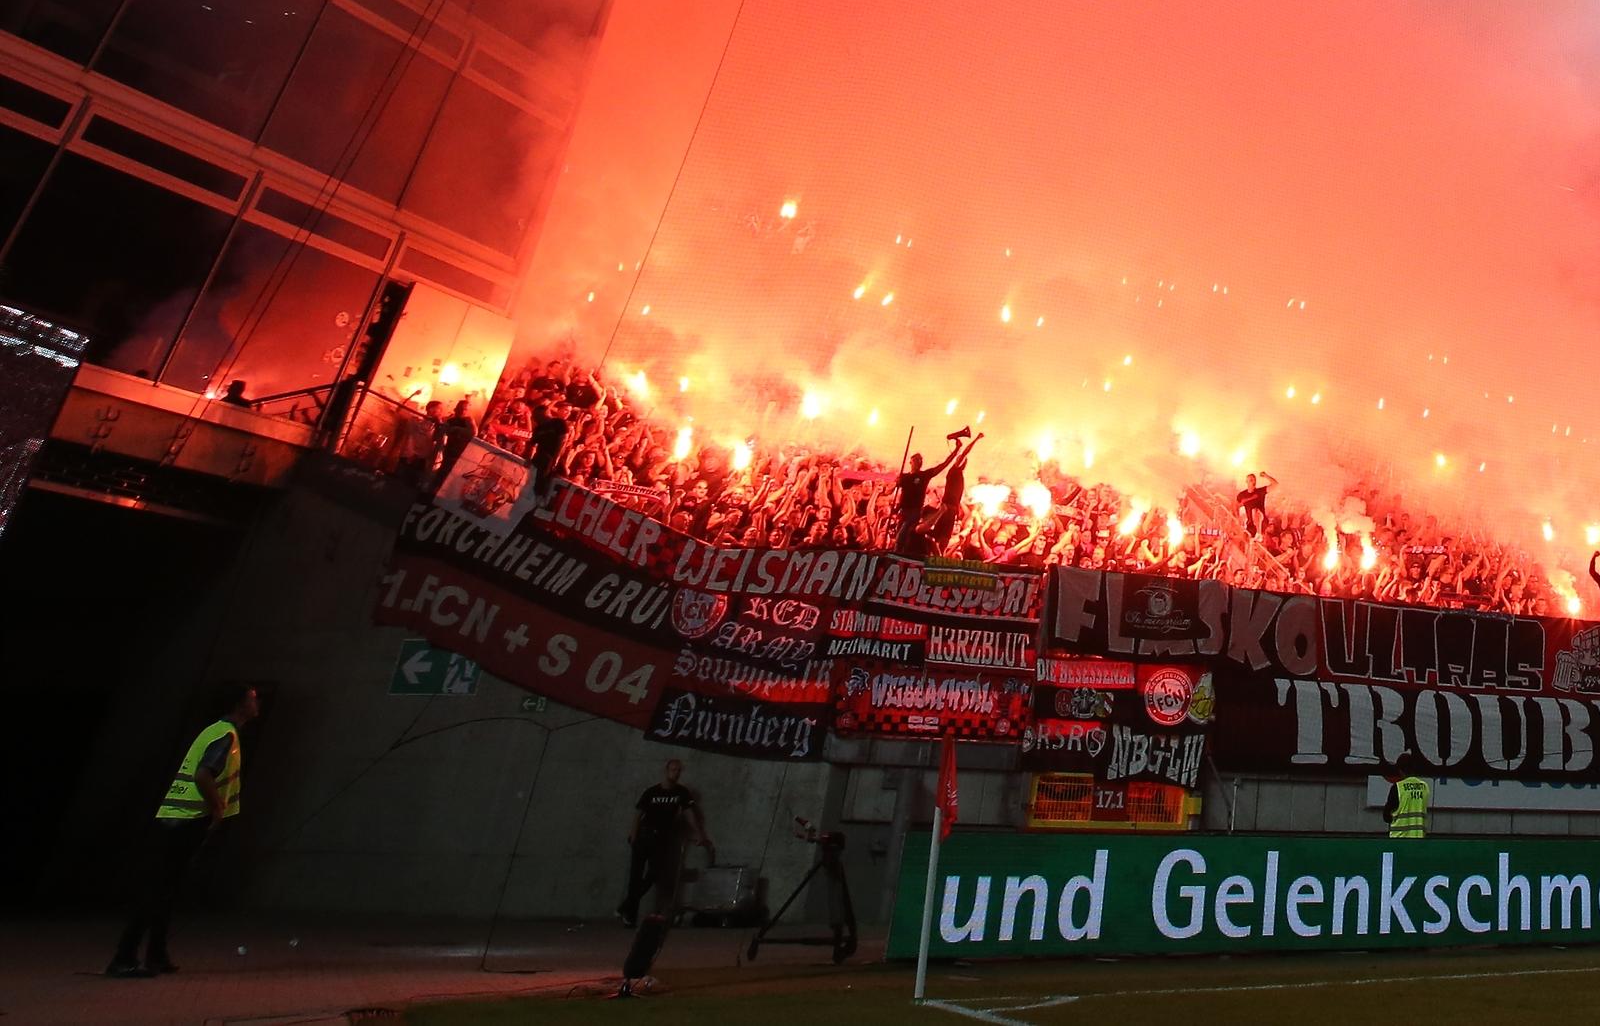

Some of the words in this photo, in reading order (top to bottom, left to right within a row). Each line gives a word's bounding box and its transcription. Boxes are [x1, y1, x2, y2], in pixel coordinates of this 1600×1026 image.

[400, 503, 589, 596] FORCHHEIM
[673, 538, 879, 601] WEISMAIN
[537, 632, 579, 677] S
[584, 651, 656, 706] 04
[827, 638, 913, 662] NEUMARKT
[929, 625, 1031, 668] H3RZBLUT
[1319, 600, 1546, 692] ULTRAS
[654, 692, 817, 759] Nürnberg
[1156, 689, 1184, 712] FCN
[939, 849, 1109, 944] und
